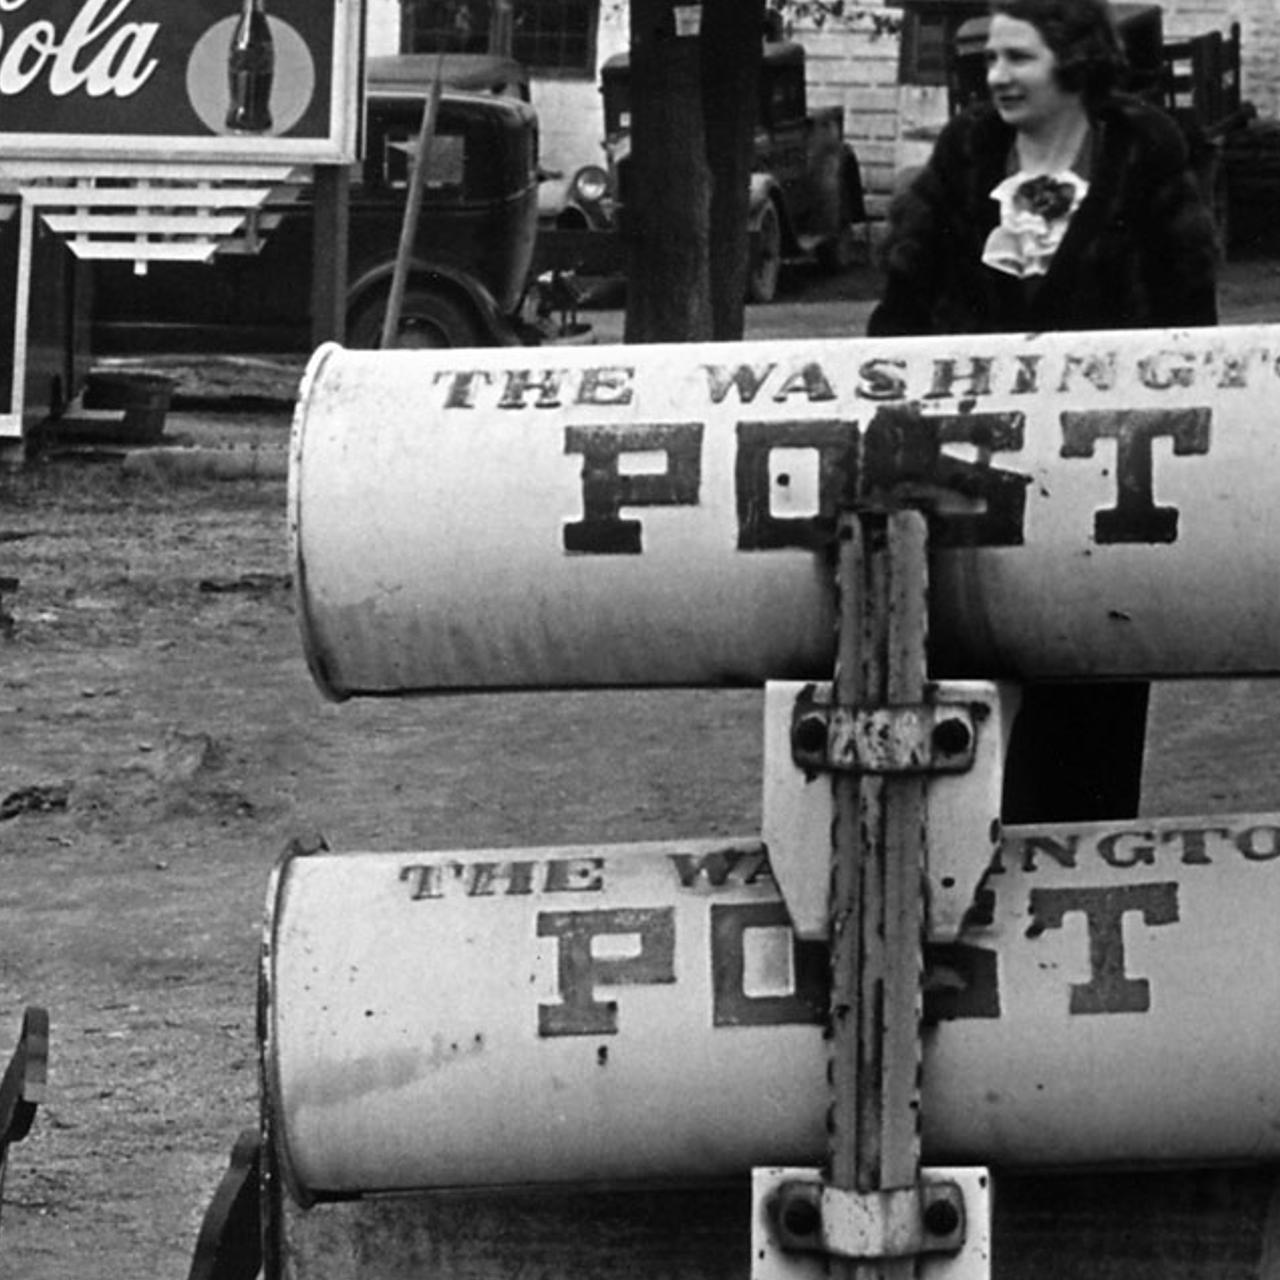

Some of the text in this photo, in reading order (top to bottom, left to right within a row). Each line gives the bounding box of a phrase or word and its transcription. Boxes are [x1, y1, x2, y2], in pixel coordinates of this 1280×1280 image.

[432, 347, 1280, 410] THE WASHINGT
[563, 406, 1213, 555] POST
[399, 856, 605, 900] THE
